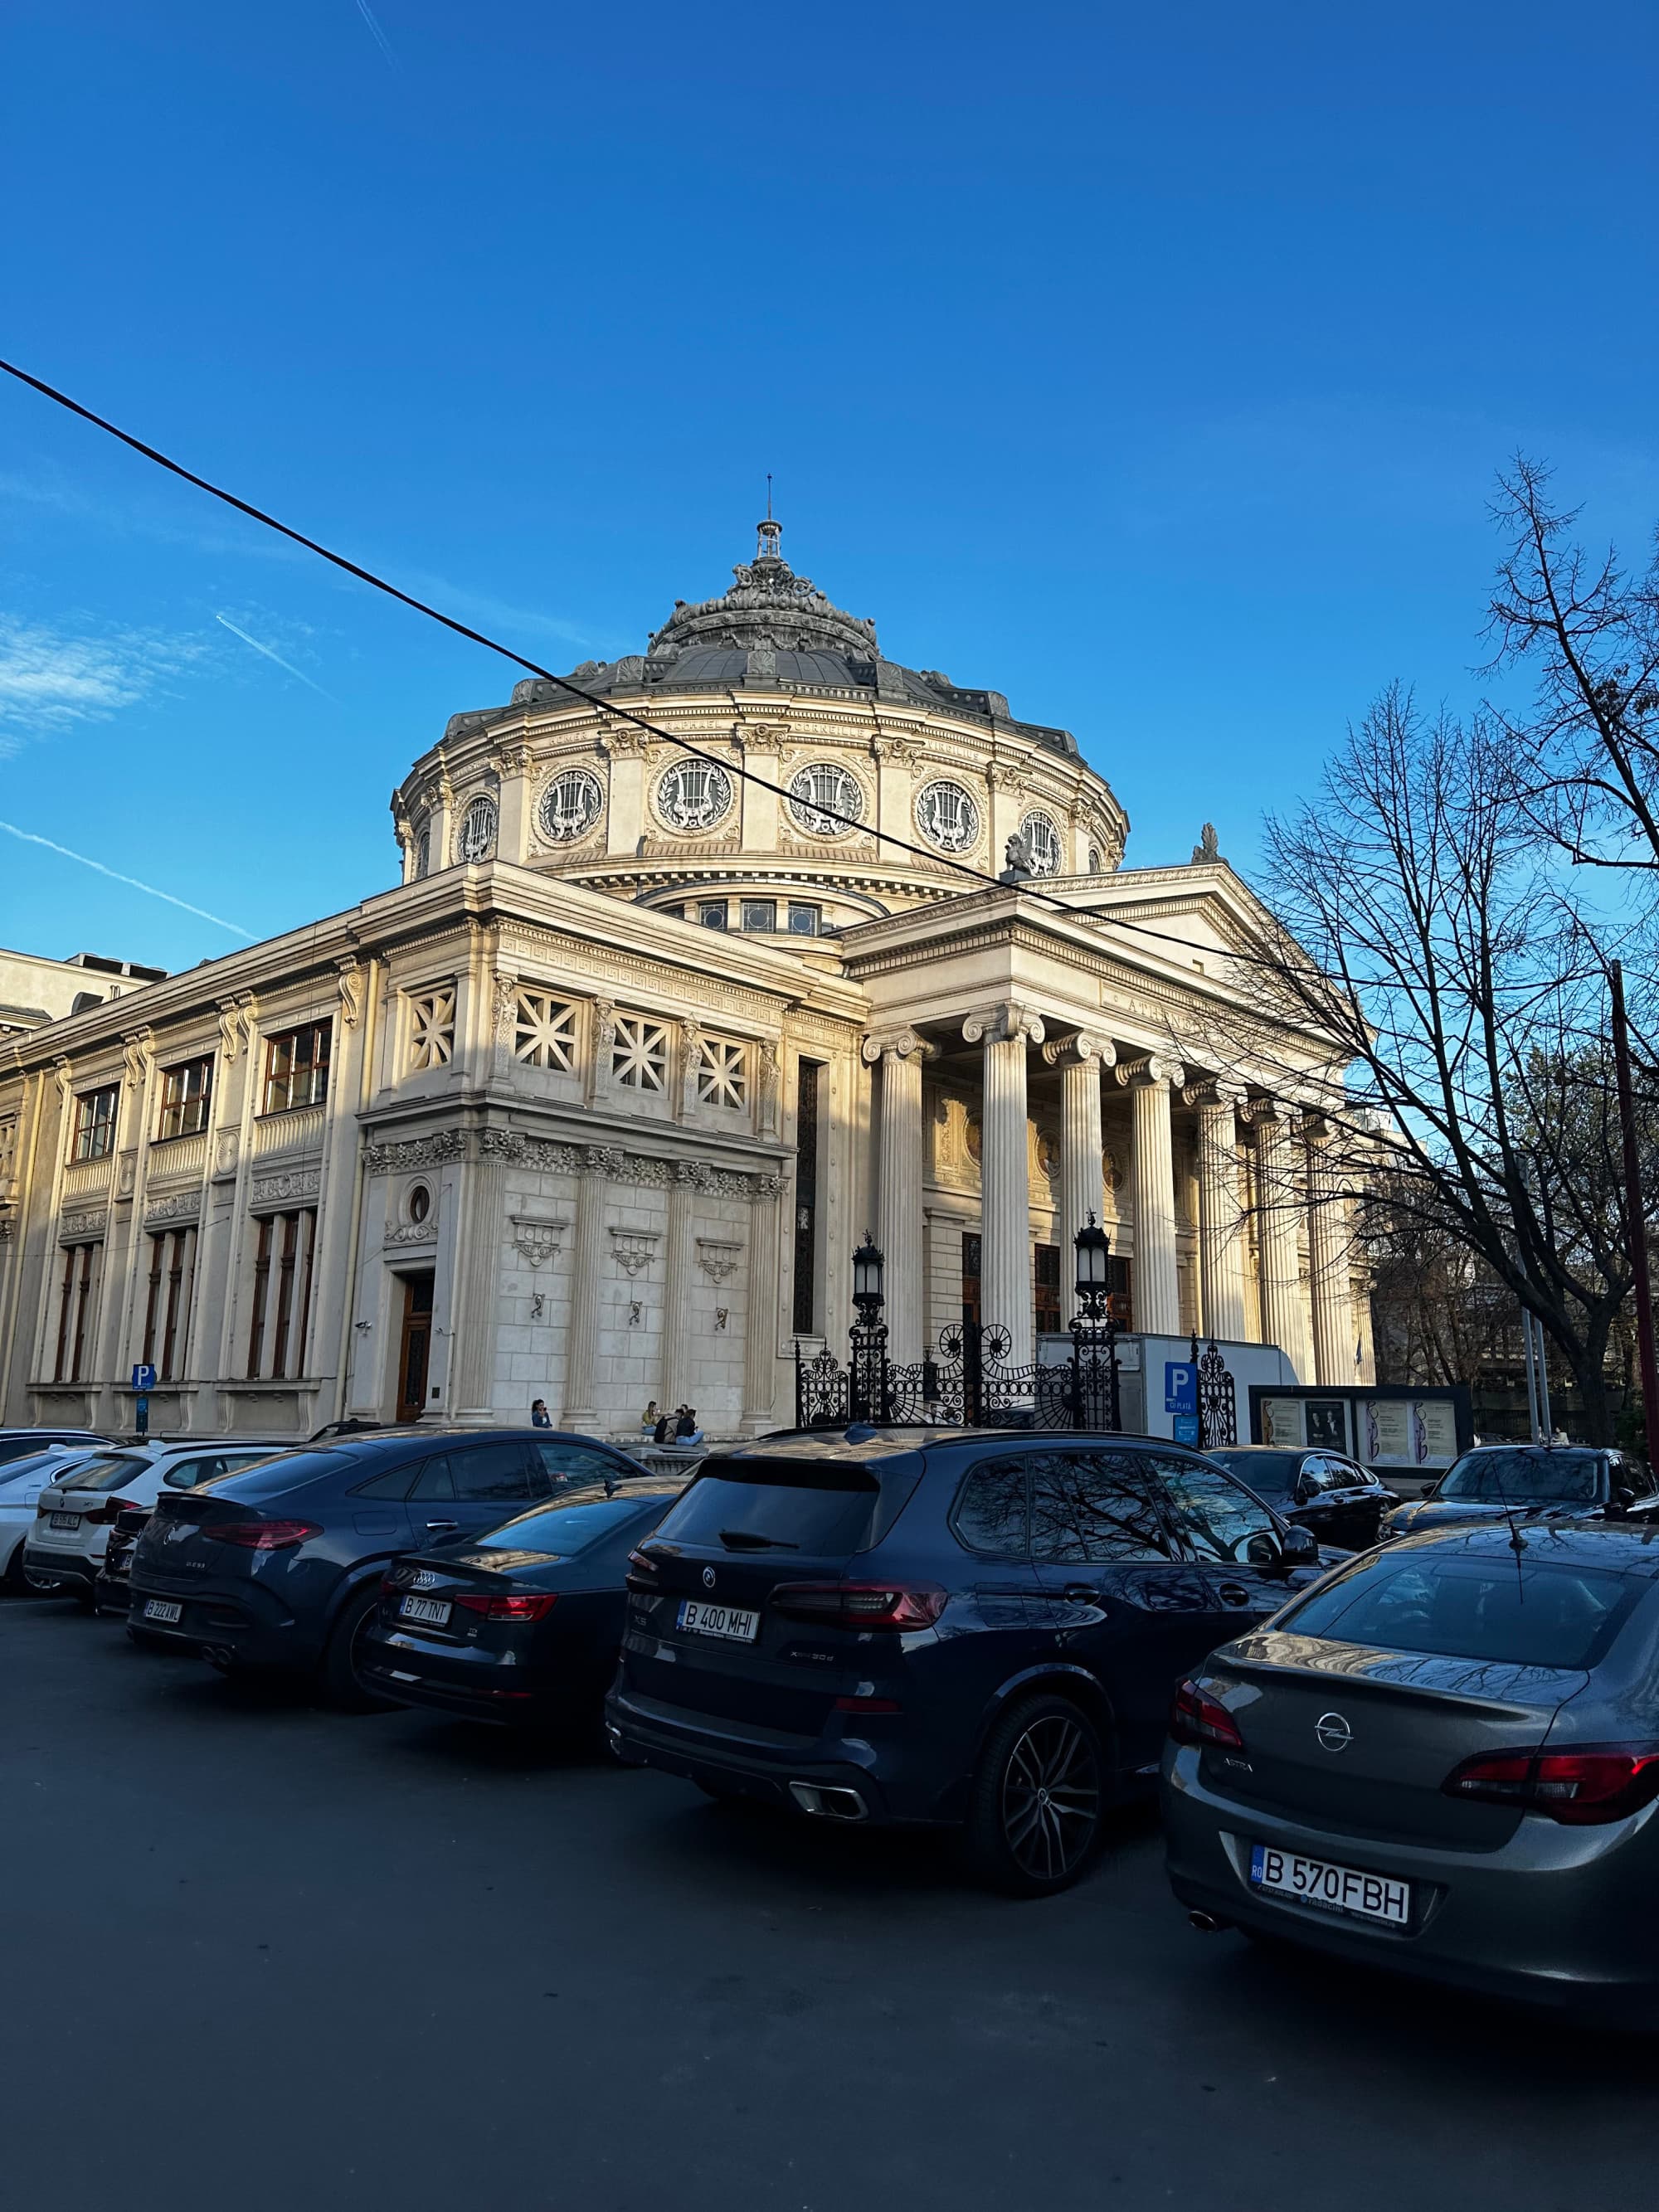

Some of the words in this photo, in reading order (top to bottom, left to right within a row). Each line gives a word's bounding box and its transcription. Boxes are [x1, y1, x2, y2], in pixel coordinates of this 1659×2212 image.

[665, 720, 722, 730] RAPHAEL
[795, 723, 864, 737] CORNEILLE
[550, 732, 587, 746] HOMER
[928, 740, 980, 761] VIRGILIUS
[138, 1365, 149, 1386] P
[1172, 1369, 1189, 1397] P
[147, 1602, 154, 1615] B
[153, 1602, 167, 1617] 222
[406, 1597, 413, 1613] B
[415, 1599, 427, 1616] 77
[428, 1602, 446, 1620] TNT
[687, 1605, 698, 1625] B
[700, 1607, 725, 1630] 400
[728, 1612, 752, 1636] MHI
[1224, 1757, 1253, 1772] ASTRA
[1253, 1865, 1262, 1878] RO
[1266, 1851, 1283, 1883] B
